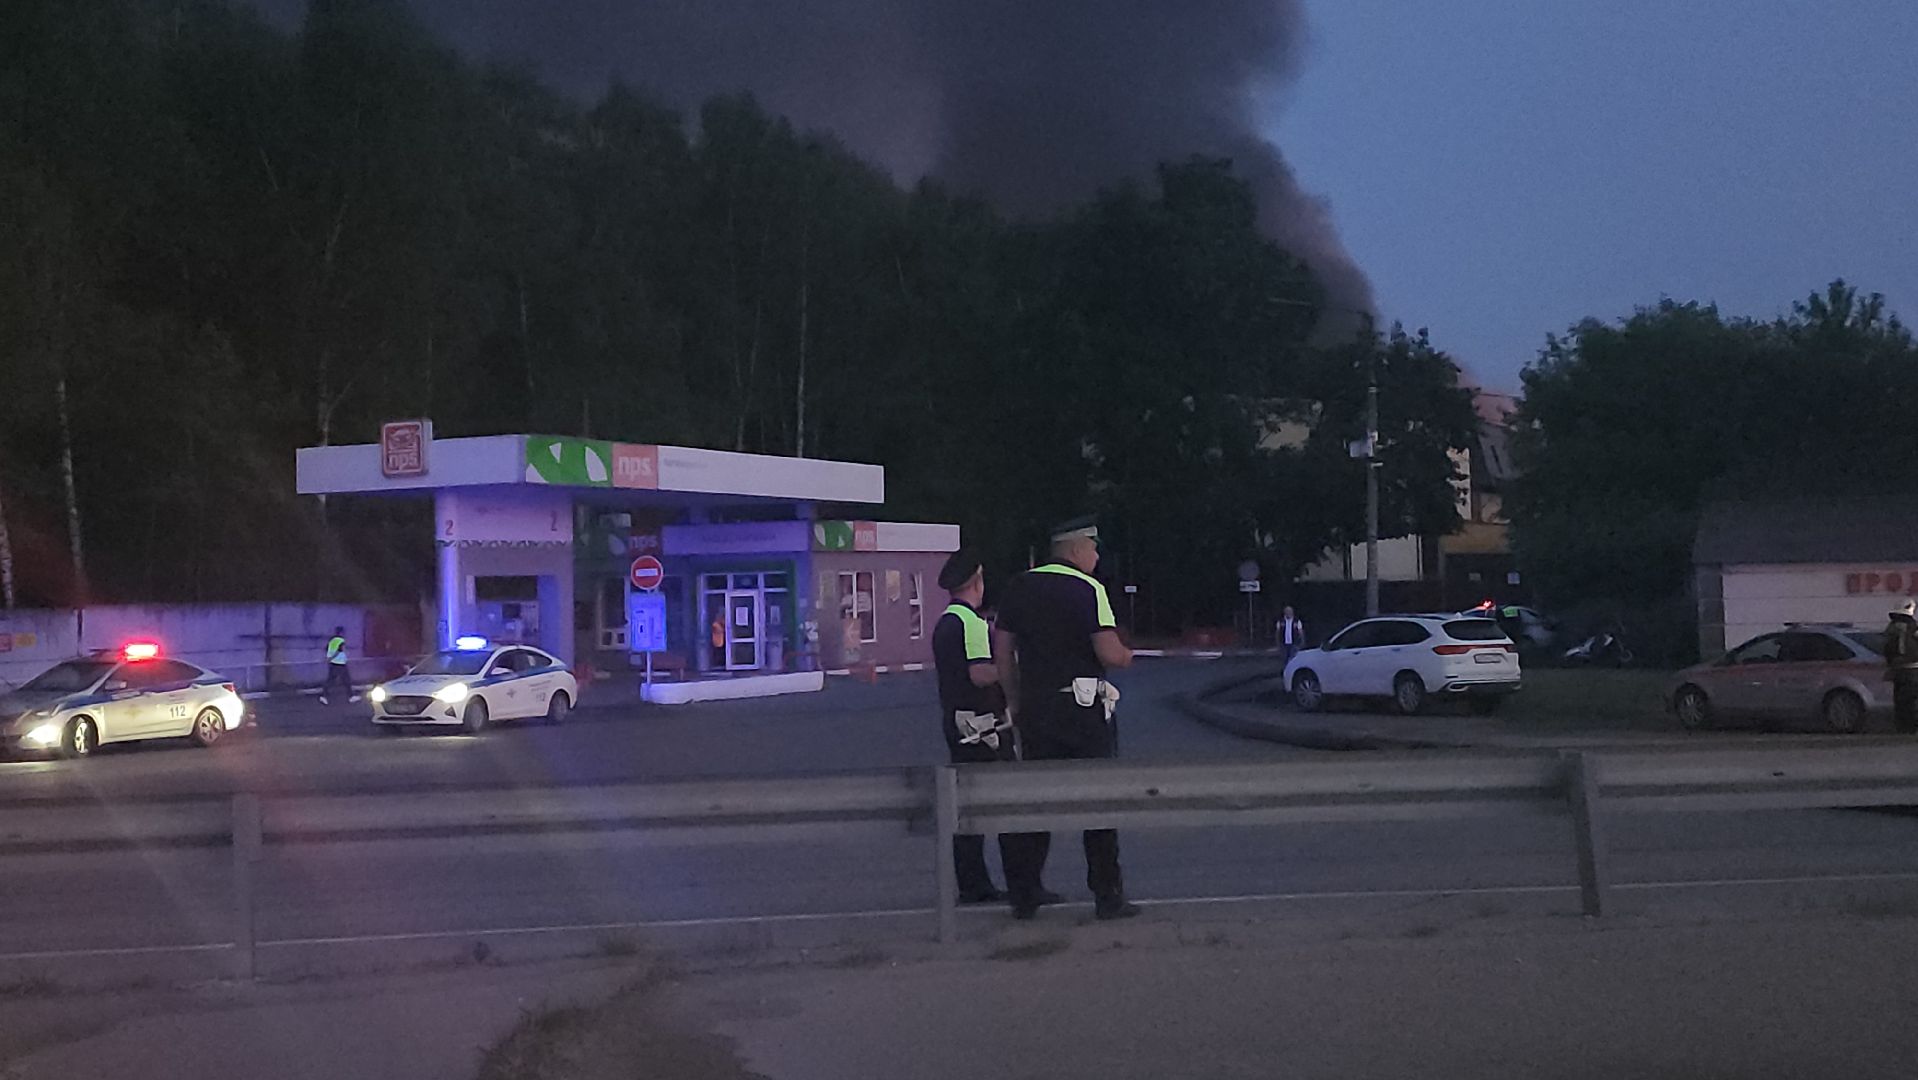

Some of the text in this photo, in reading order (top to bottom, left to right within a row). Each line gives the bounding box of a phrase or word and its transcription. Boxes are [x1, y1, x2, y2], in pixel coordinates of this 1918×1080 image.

[387, 454, 418, 471] nps
[618, 456, 652, 481] nps
[445, 519, 454, 536] 2
[168, 705, 186, 718] 112
